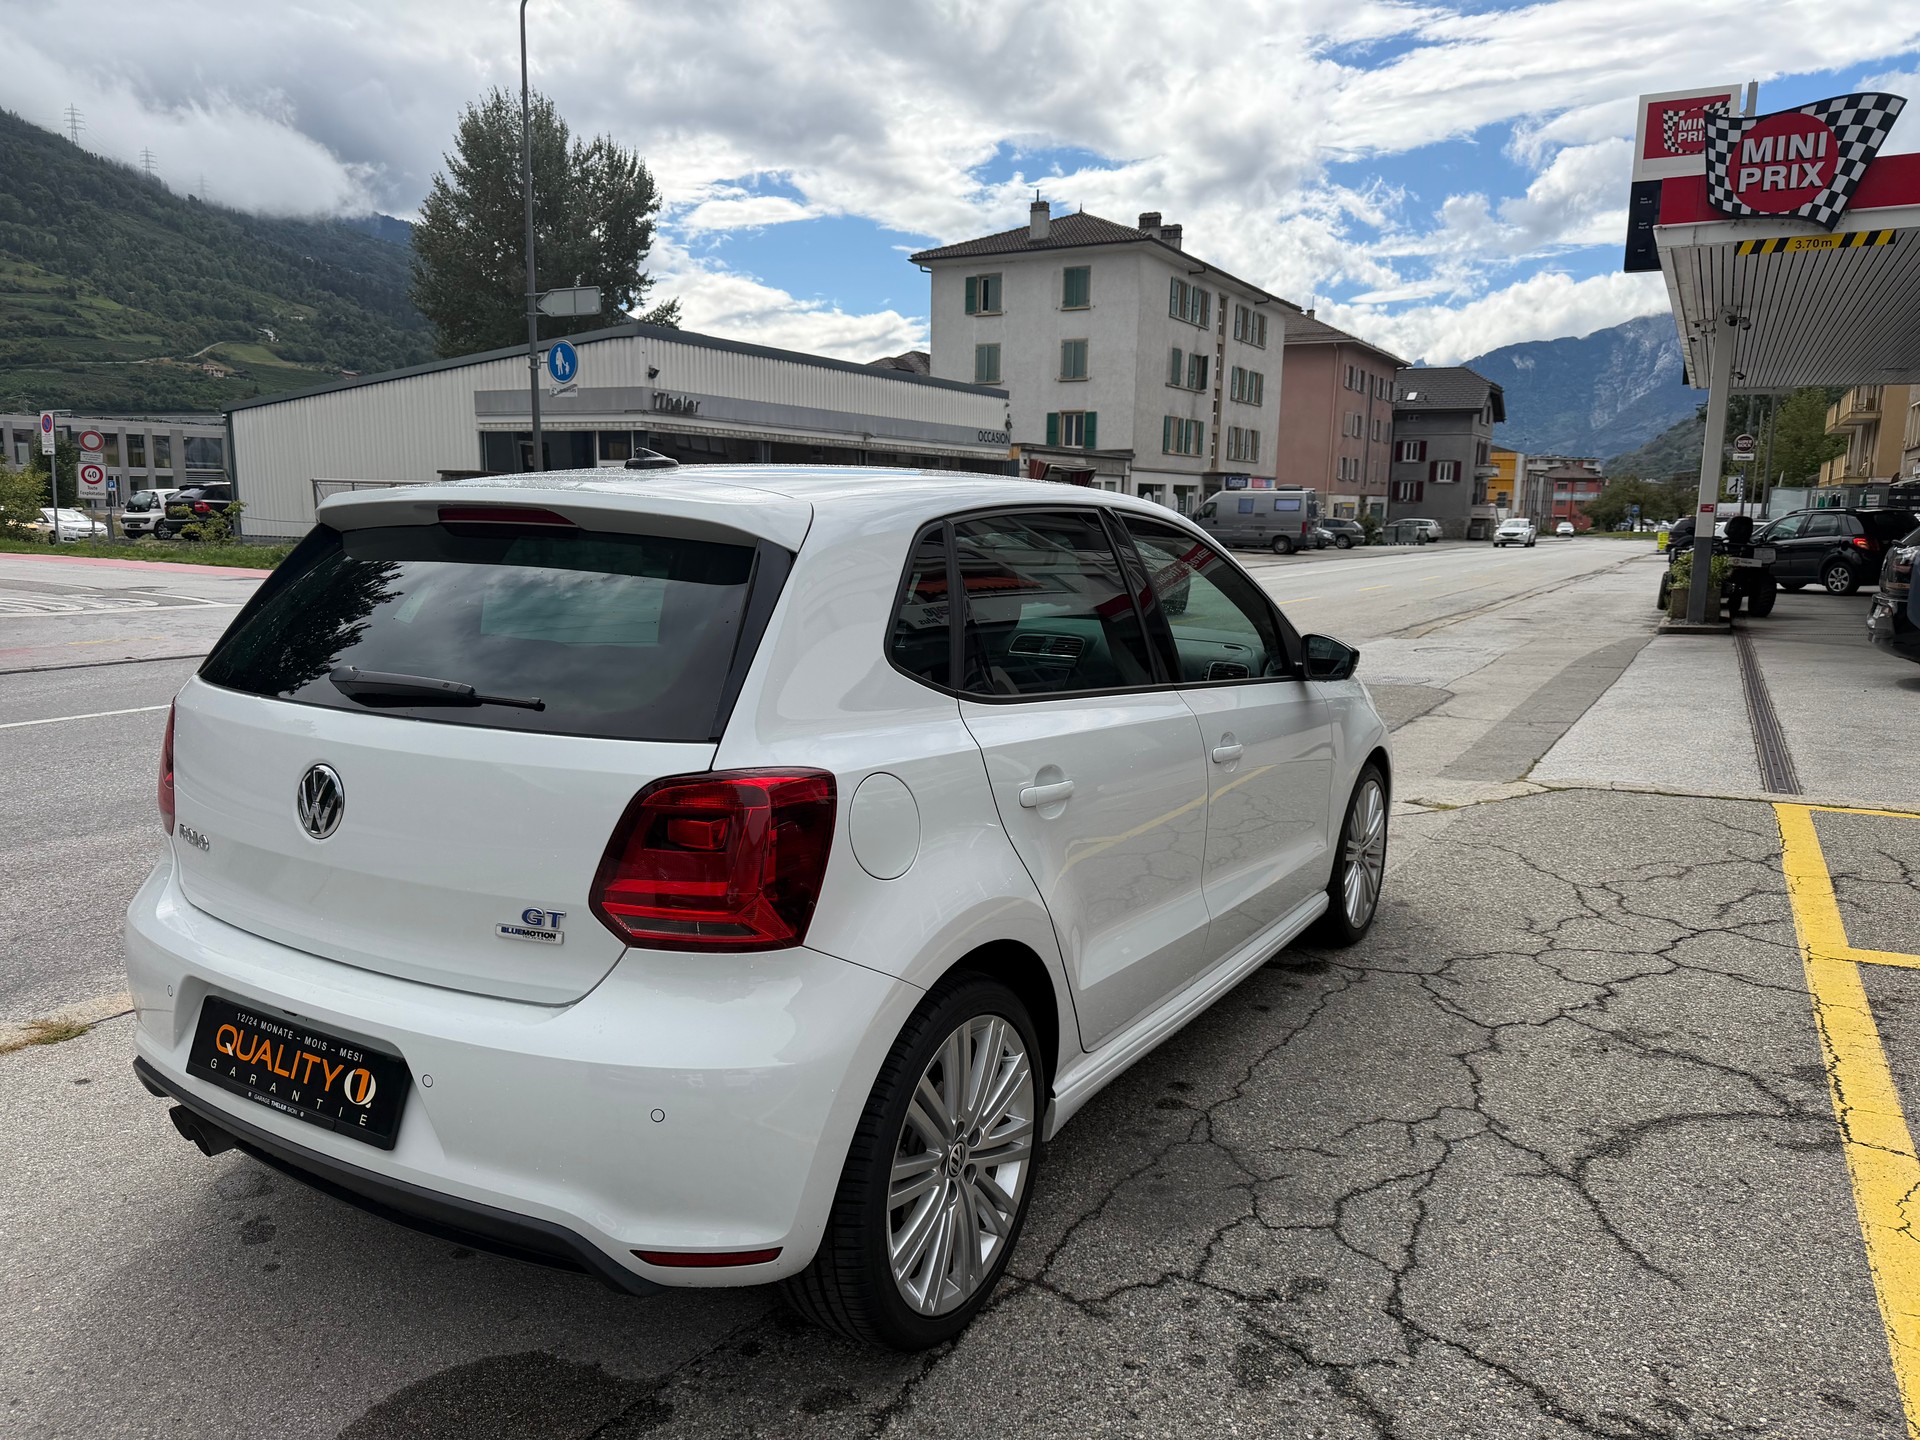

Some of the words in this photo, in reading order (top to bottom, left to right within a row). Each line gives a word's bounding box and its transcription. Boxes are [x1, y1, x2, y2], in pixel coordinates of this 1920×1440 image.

[1679, 118, 1705, 131] MIN
[1678, 131, 1705, 143] PRI
[1742, 131, 1828, 165] MINI
[1738, 161, 1825, 194] PRIX
[977, 430, 1010, 444] OCCASION
[87, 470, 97, 479] 40
[521, 907, 567, 930] GT
[500, 926, 557, 940] BLUEMOTION
[236, 1012, 258, 1027] 12/24
[260, 1022, 294, 1040] MONATE
[304, 1036, 328, 1051] MOIS
[339, 1047, 364, 1063] MESI
[215, 1023, 345, 1093] QUALITY
[210, 1058, 368, 1126] GARANTIE
